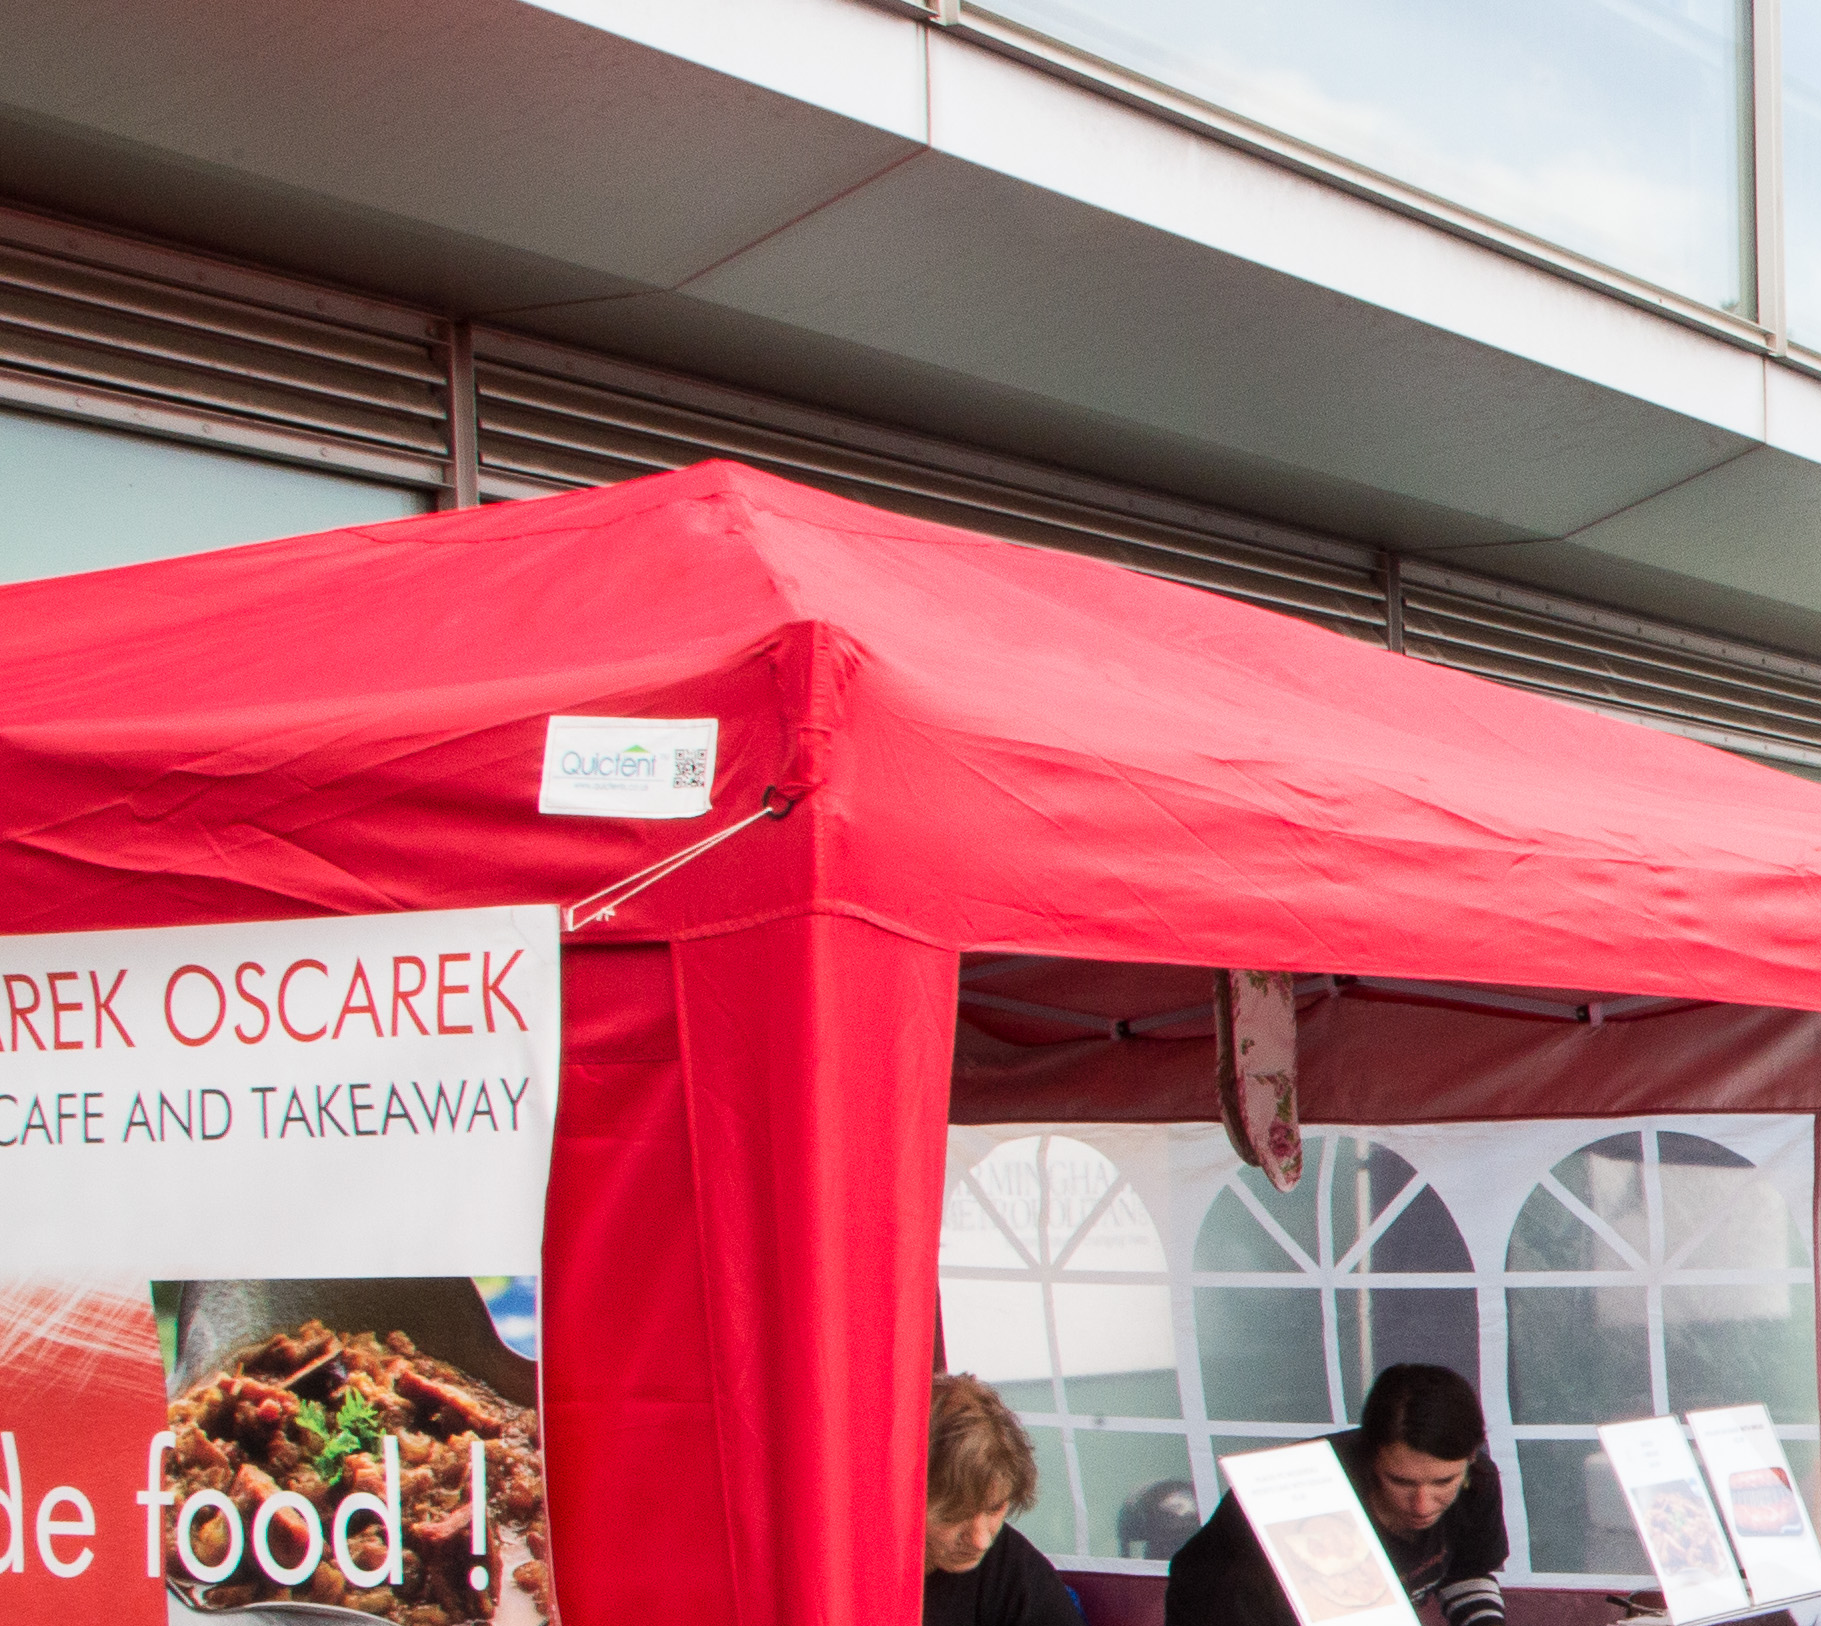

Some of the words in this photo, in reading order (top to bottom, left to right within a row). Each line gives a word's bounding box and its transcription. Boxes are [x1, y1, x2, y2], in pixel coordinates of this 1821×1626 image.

[562, 750, 657, 777] Quictent
[0, 968, 136, 1052] REK
[163, 948, 528, 1048] OSCAREK
[123, 1089, 233, 1143] AND
[250, 1076, 531, 1140] TAKEAWAY
[0, 1430, 97, 1580] de
[136, 1430, 404, 1588] food
[466, 1440, 490, 1594] !
